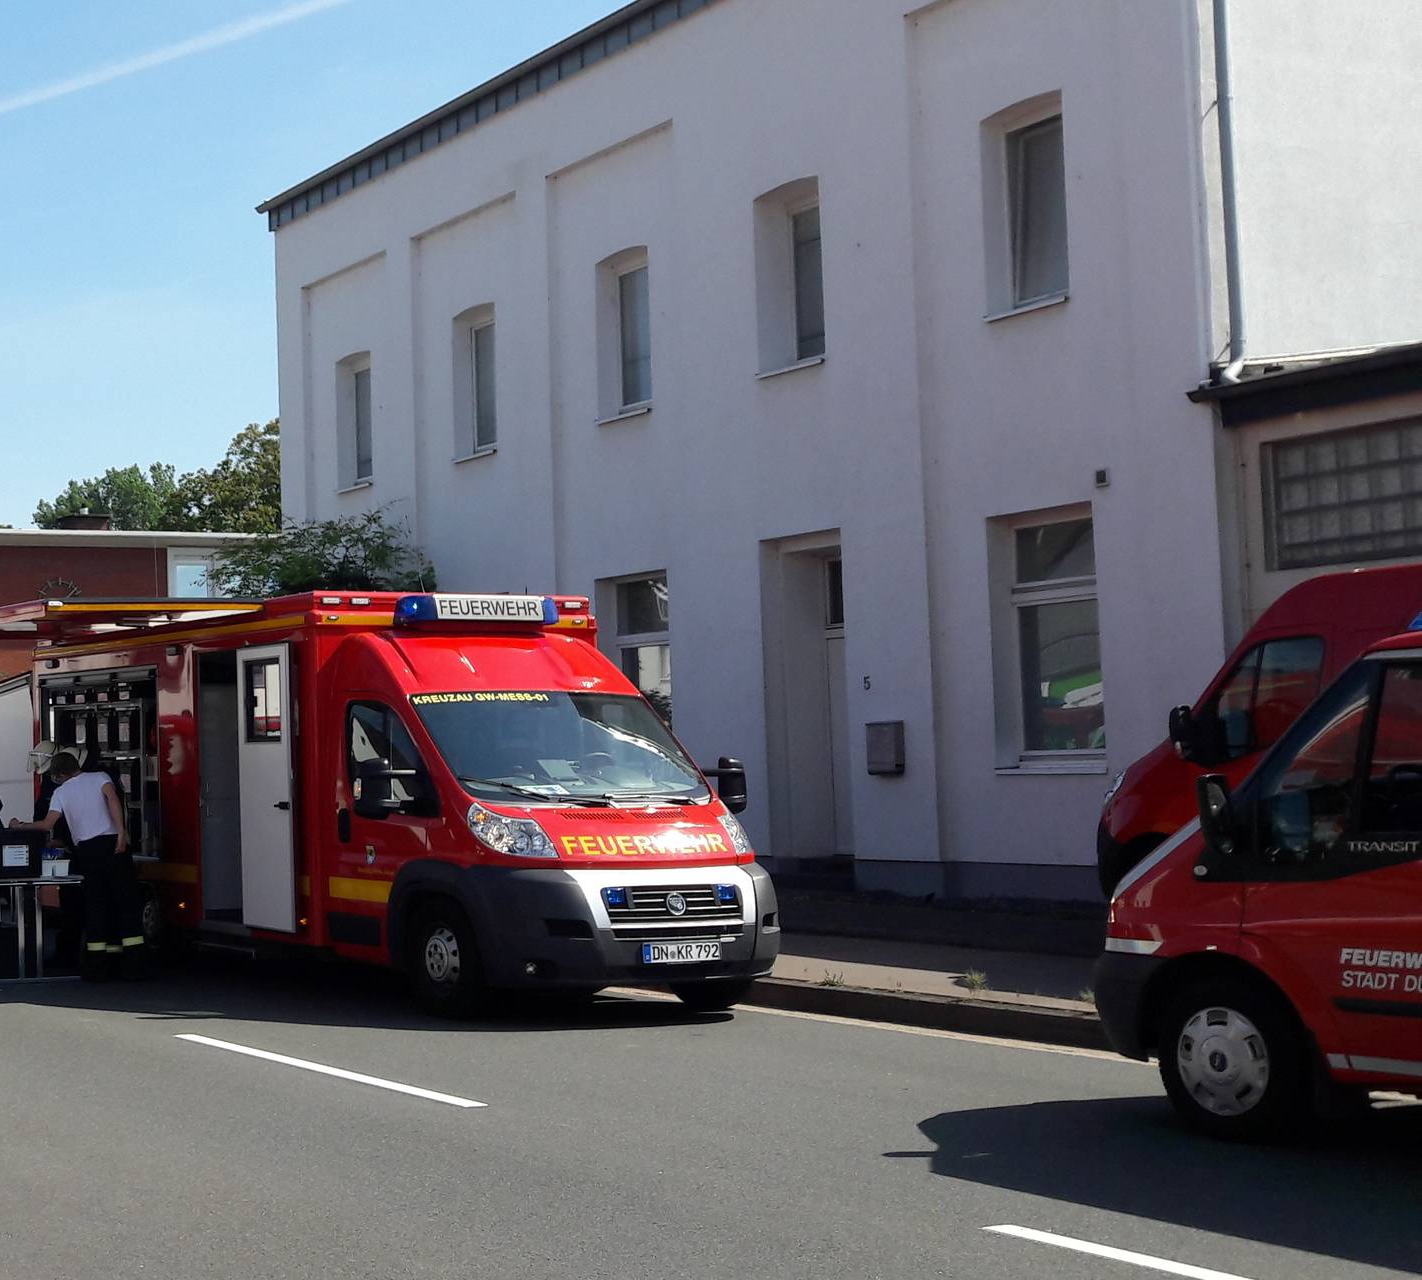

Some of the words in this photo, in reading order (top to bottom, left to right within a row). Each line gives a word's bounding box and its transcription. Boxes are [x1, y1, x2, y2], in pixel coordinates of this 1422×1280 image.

[439, 599, 539, 617] FEUERWEHR
[863, 676, 871, 690] 5
[412, 694, 473, 706] KREUZAU
[474, 693, 549, 703] GW-MESS-01
[1347, 840, 1420, 852] TRANSIT
[652, 945, 669, 961] DN
[677, 944, 693, 960] KR
[696, 943, 720, 959] 792
[1341, 970, 1399, 990] STADT
